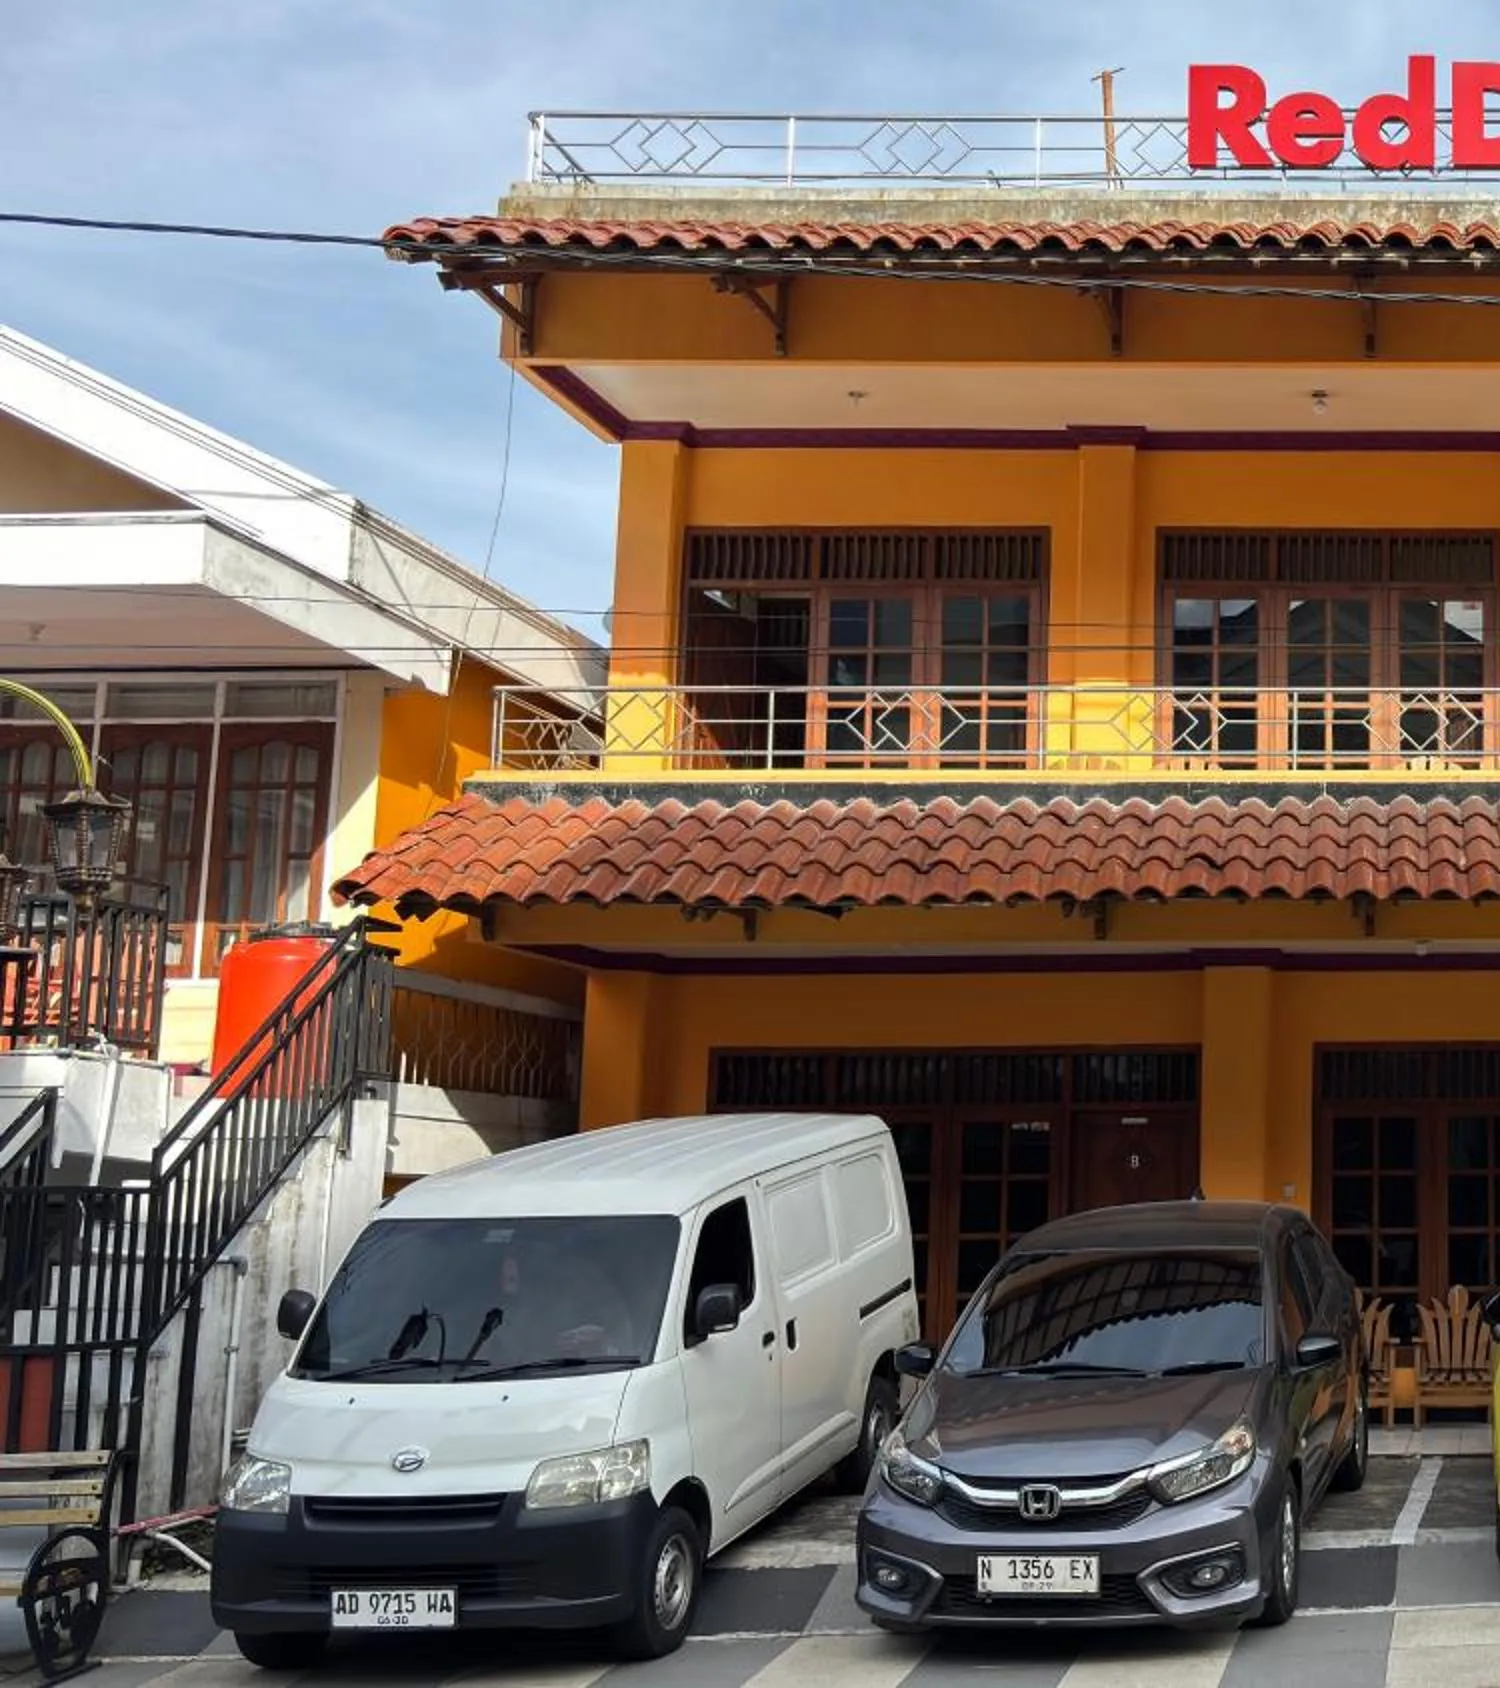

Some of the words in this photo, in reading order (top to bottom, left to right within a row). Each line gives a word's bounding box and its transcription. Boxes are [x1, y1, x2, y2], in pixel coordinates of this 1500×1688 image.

[981, 1560, 992, 1579] N
[1008, 1560, 1055, 1579] 1356
[1070, 1560, 1093, 1579] EX
[336, 1594, 359, 1614] AD
[369, 1594, 416, 1614] 9715
[427, 1593, 452, 1613] WA
